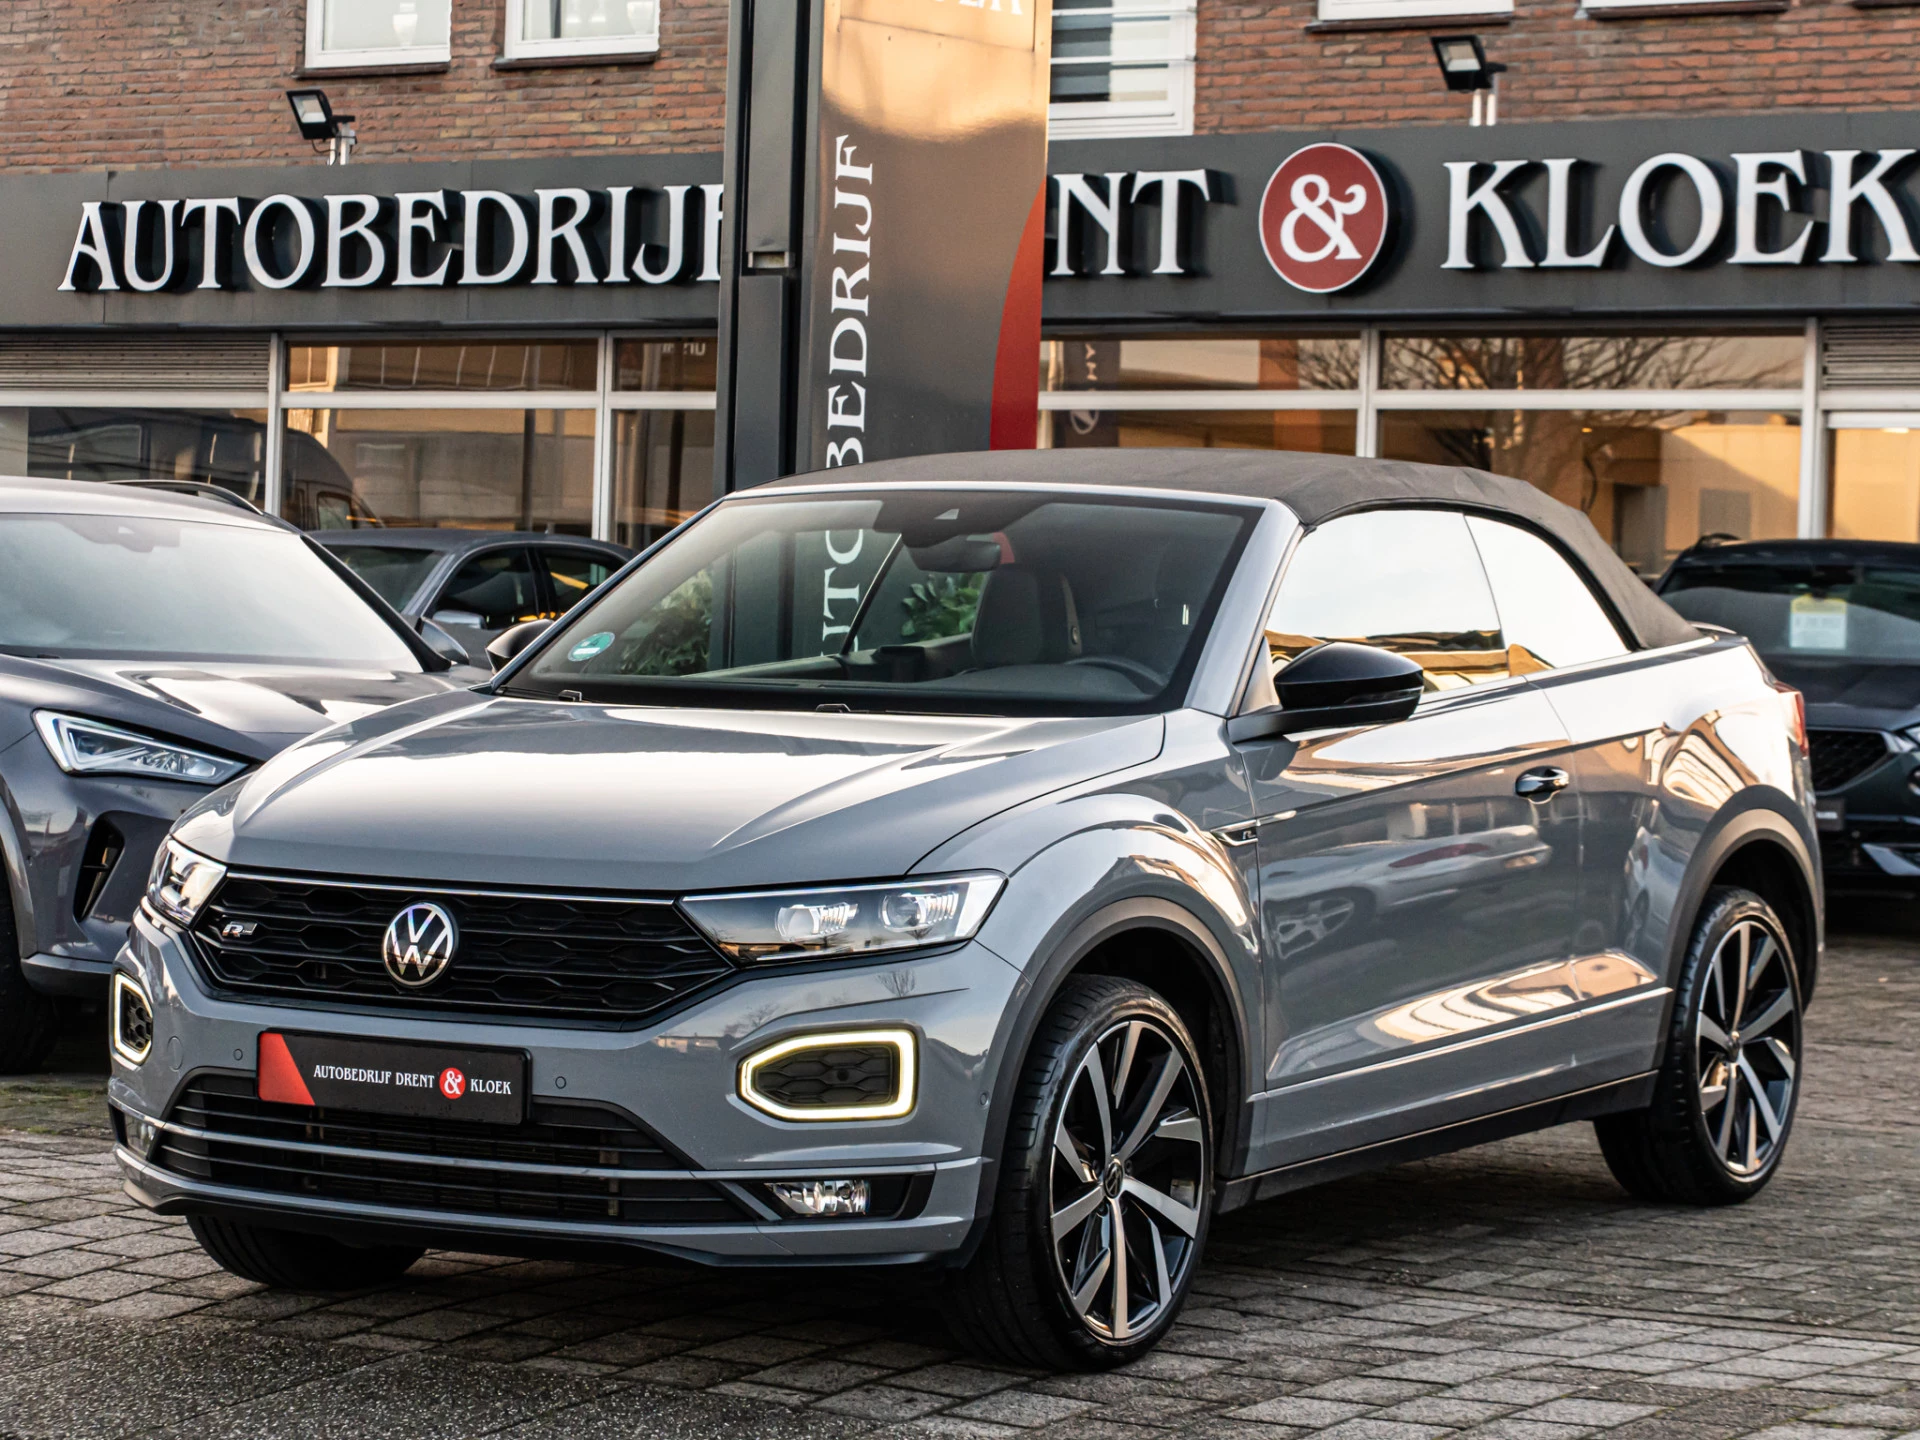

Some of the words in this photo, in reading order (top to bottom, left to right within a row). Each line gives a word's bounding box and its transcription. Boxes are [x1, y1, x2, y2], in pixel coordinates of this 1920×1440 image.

[1050, 169, 1210, 275] NT
[1440, 148, 1920, 269] KLOEK
[313, 1064, 392, 1085] AUTOBEDRIJF
[395, 1072, 435, 1089] DRENT
[470, 1078, 512, 1095] KLOEK
